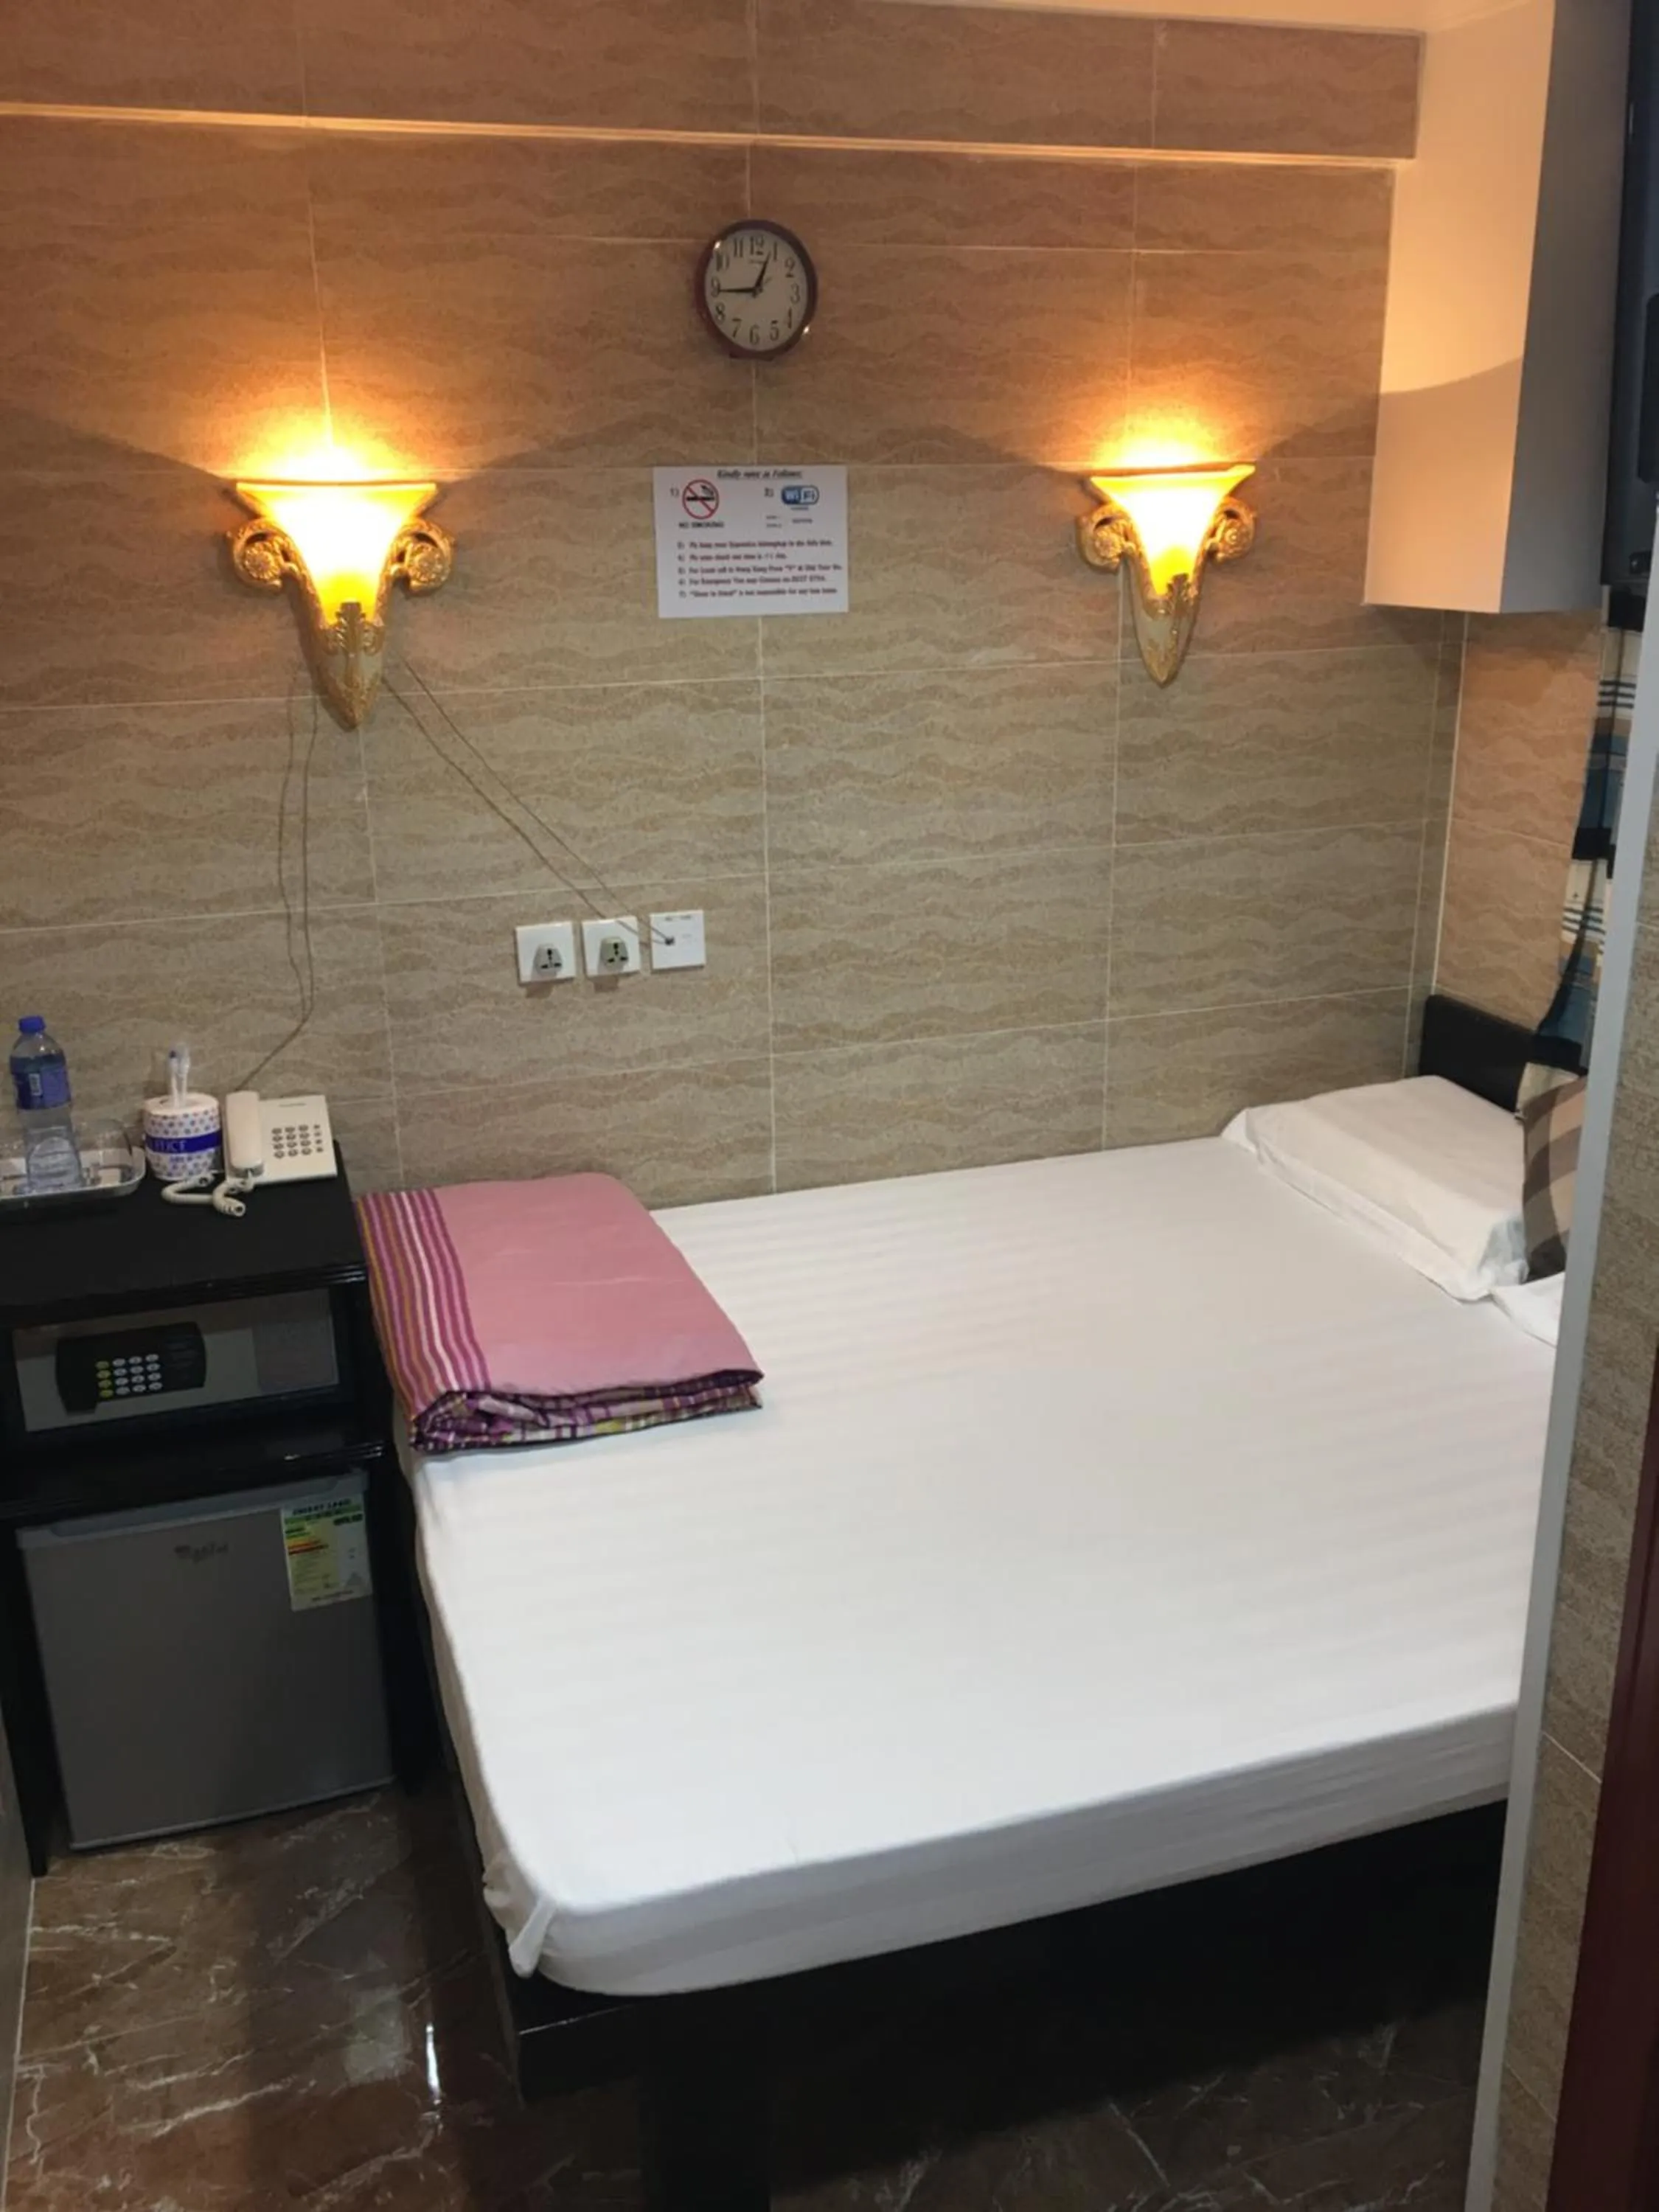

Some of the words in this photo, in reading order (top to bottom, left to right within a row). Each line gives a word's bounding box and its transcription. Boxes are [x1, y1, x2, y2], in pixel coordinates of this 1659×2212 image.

[734, 237, 744, 258] 11
[749, 236, 765, 256] 12
[785, 257, 795, 279] 2
[711, 276, 720, 298] 9
[790, 282, 801, 305] 3
[714, 302, 726, 324] 8
[731, 318, 742, 338] 7
[749, 324, 760, 345] 6
[769, 319, 779, 341] 5
[717, 469, 741, 480] Kindly
[691, 521, 725, 529] SMOKING
